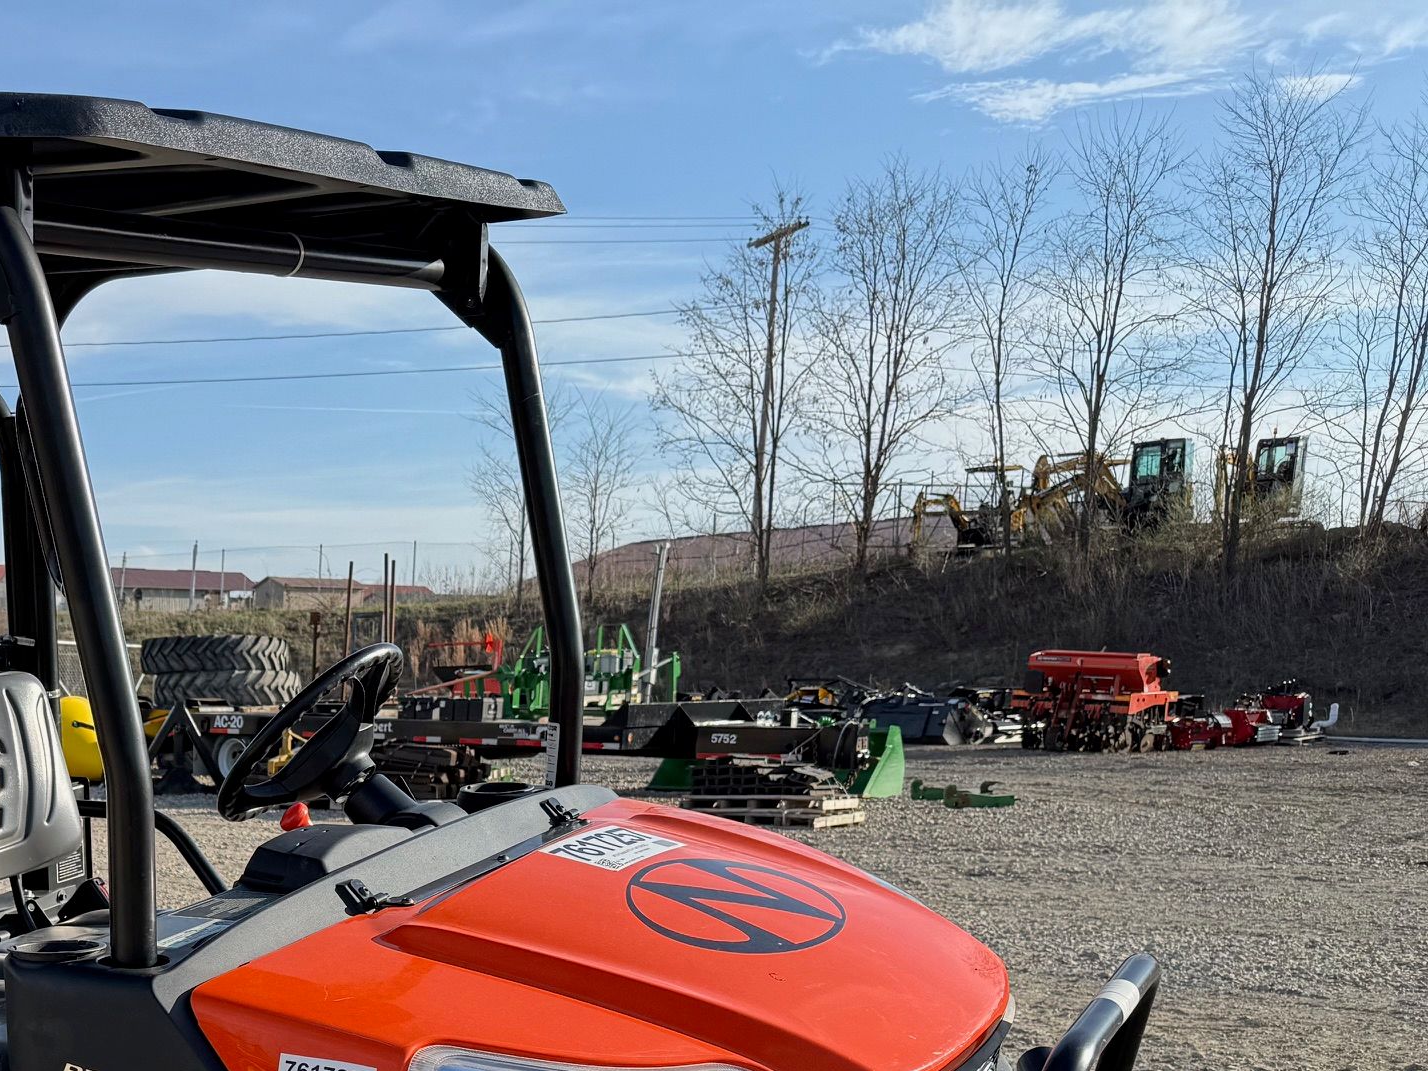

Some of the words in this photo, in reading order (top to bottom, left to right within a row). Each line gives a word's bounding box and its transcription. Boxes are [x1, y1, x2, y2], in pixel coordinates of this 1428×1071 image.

[213, 715, 244, 728] AC-20
[711, 733, 737, 744] 5752
[548, 828, 653, 861] 7617257
